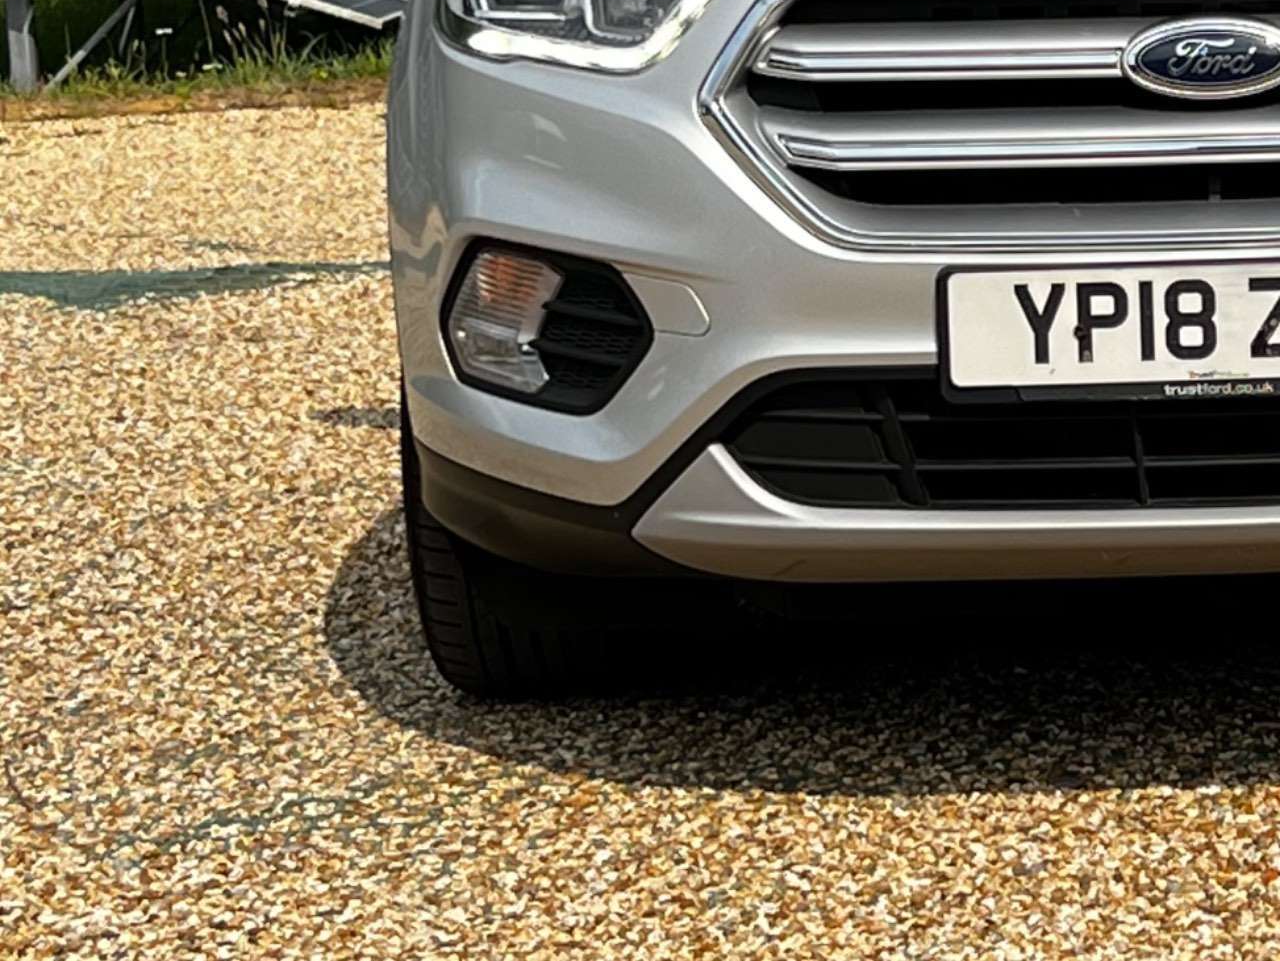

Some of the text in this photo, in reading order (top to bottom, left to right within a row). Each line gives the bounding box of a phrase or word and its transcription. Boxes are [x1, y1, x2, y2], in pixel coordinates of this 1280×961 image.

[1168, 38, 1257, 76] Ford
[1013, 279, 1217, 365] YP18
[1163, 381, 1274, 396] trustford.co.uk
